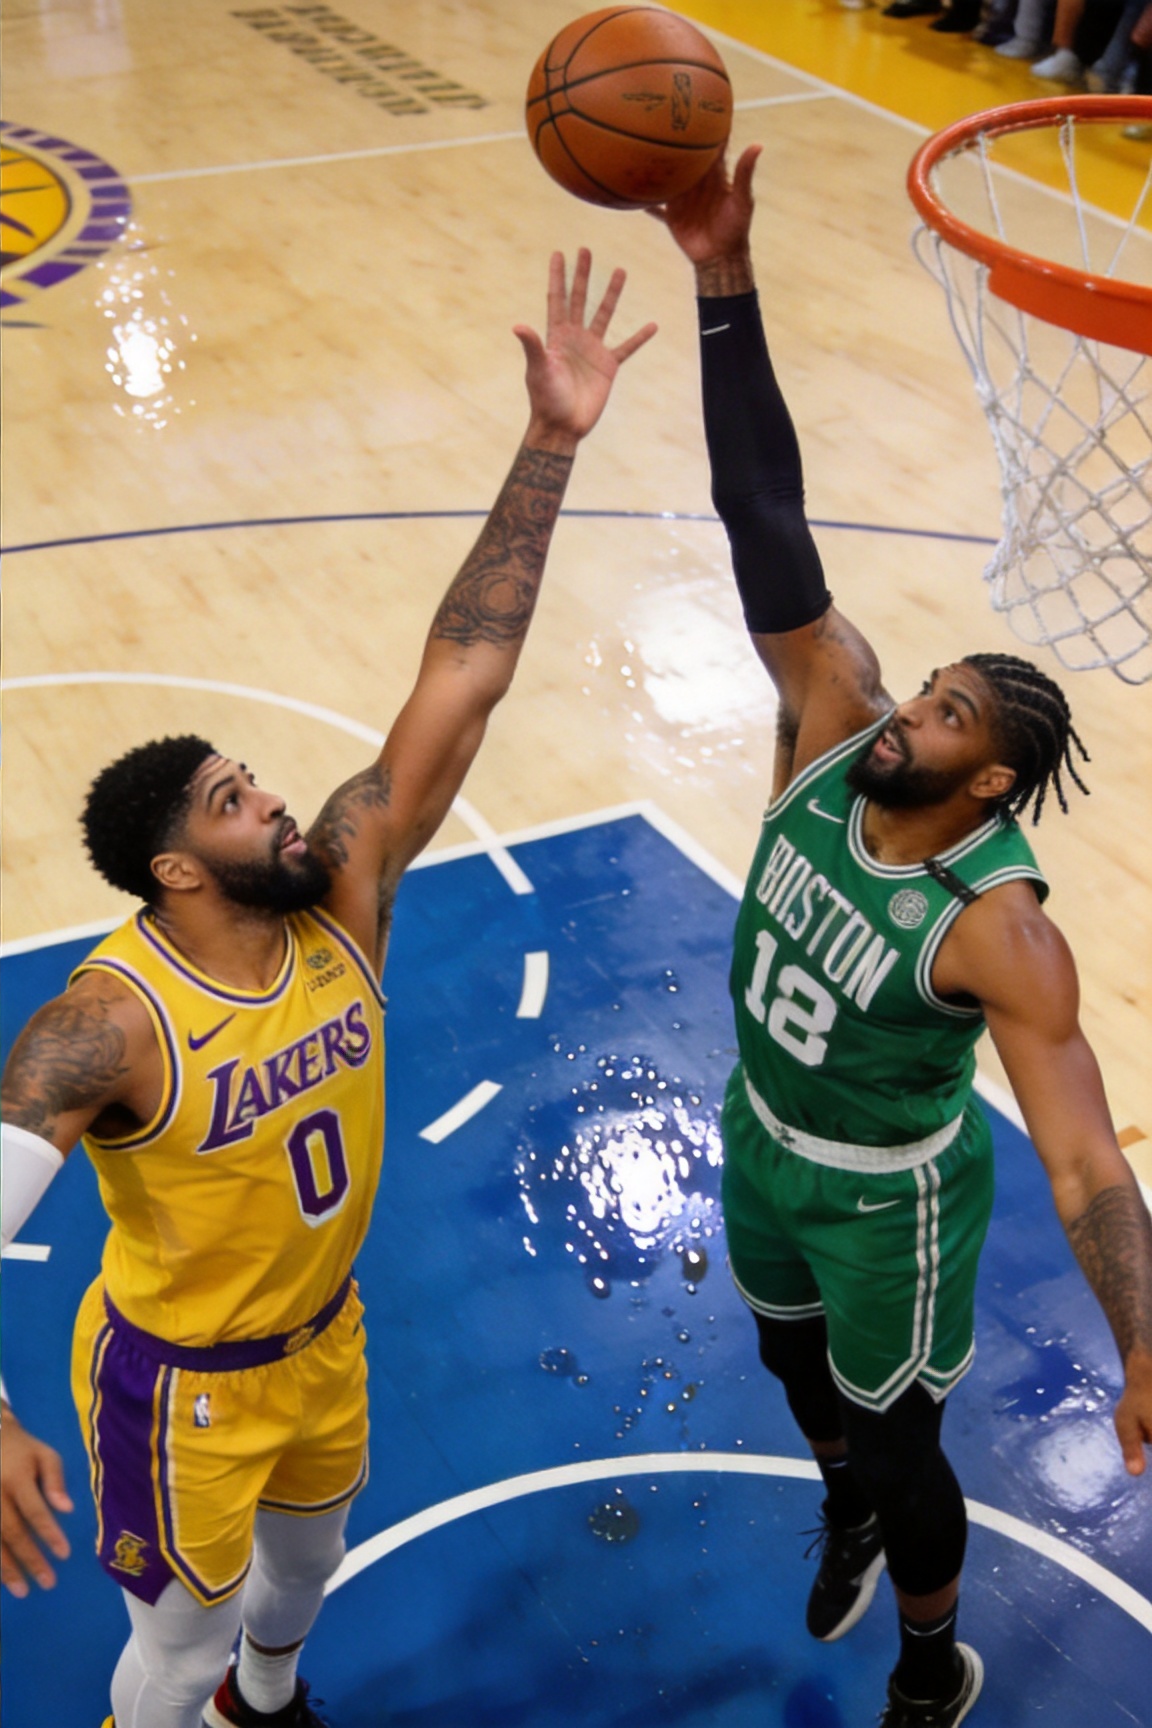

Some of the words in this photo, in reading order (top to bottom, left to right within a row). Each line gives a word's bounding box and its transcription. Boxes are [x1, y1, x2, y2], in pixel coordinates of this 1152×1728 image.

[756, 833, 901, 1013] BOSTON
[195, 998, 372, 1155] LAKERS
[283, 1106, 352, 1229] 0
